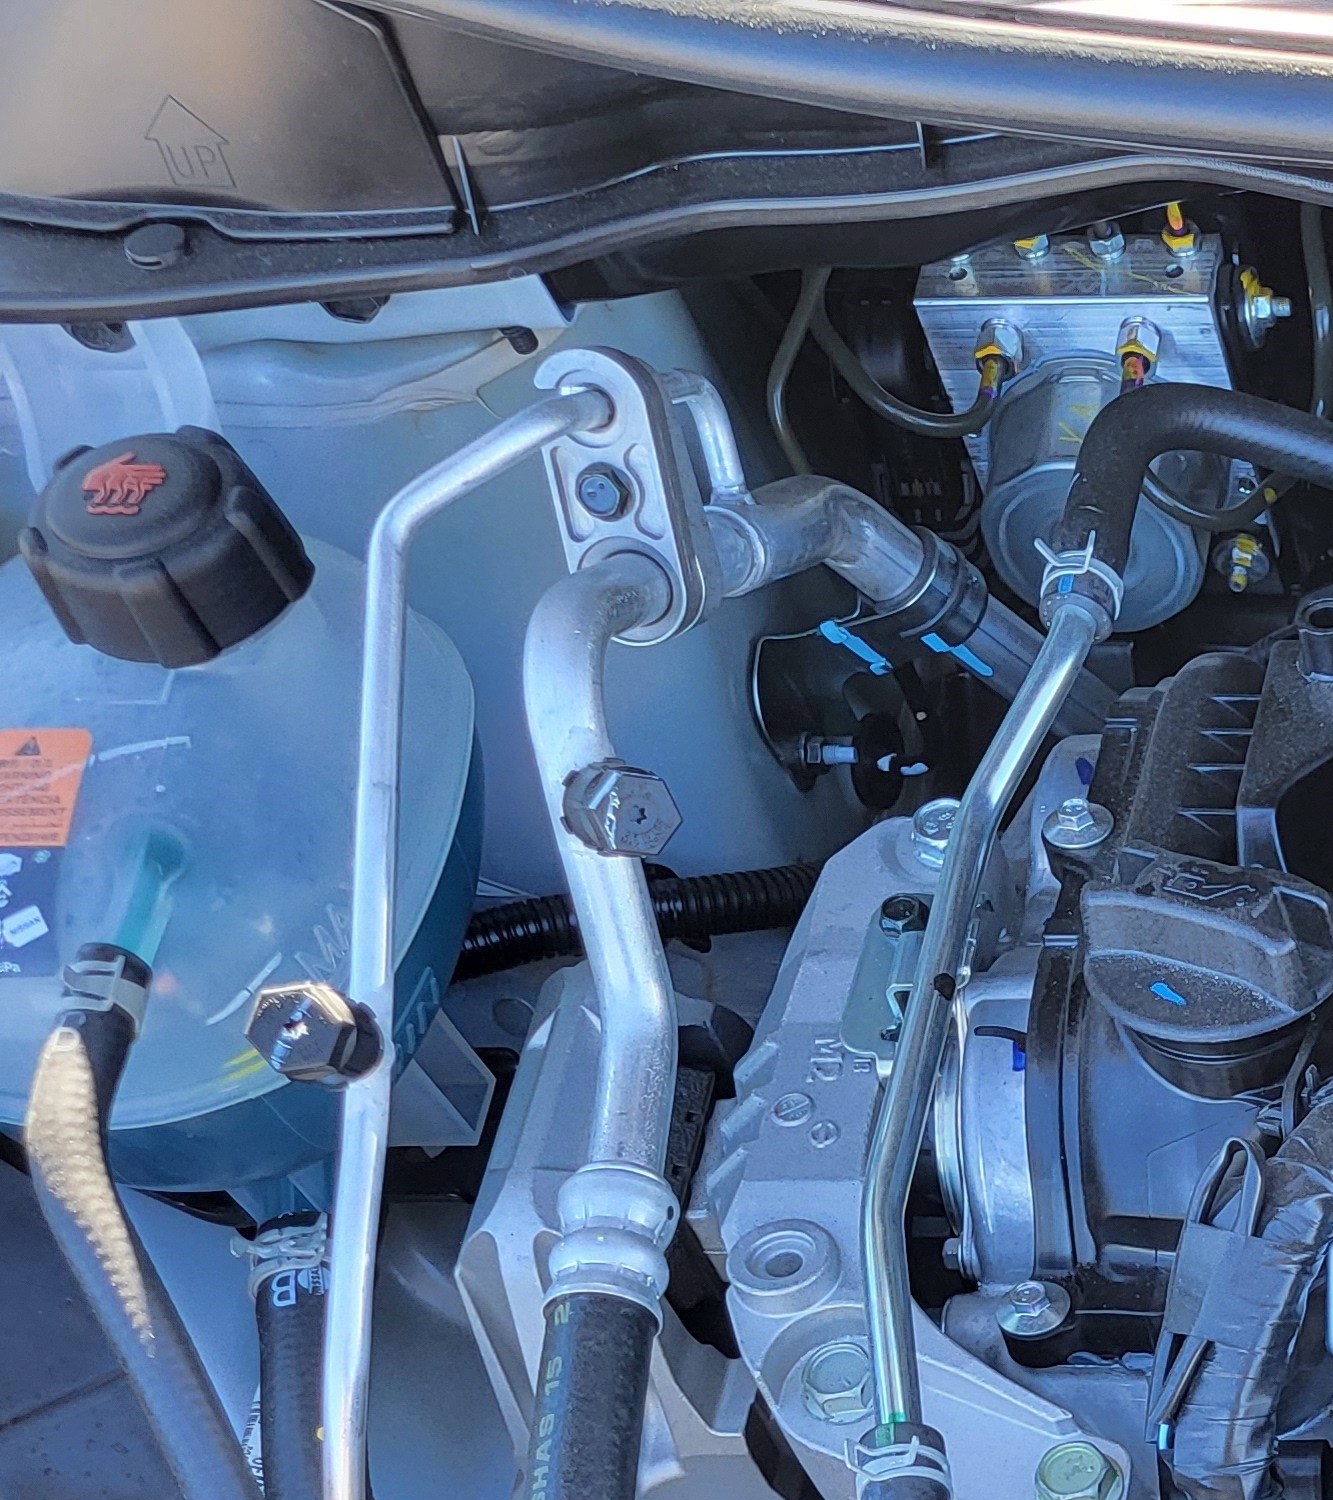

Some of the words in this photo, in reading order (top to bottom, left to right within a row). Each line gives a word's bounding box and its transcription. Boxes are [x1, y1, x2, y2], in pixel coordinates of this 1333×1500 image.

[171, 150, 218, 179] UP
[271, 1270, 297, 1308] B
[544, 1354, 564, 1394] 15
